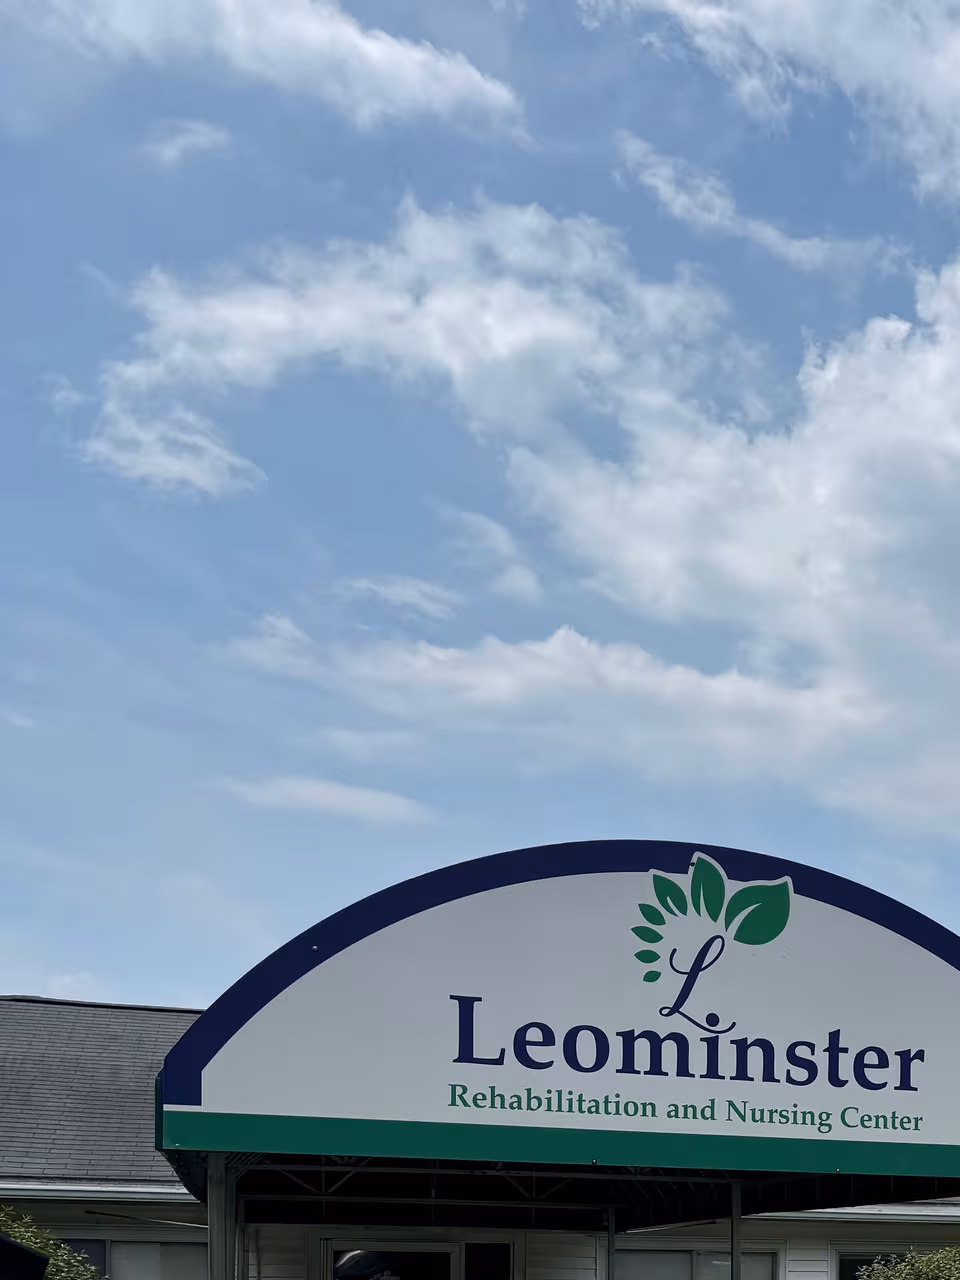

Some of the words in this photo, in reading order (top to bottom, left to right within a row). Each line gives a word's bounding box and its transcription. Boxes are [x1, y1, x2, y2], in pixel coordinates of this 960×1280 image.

[659, 934, 736, 1034] L
[449, 994, 925, 1092] Leominster
[448, 1083, 658, 1119] Rehabilitation
[666, 1098, 717, 1122] and
[725, 1100, 833, 1134] Nursing
[839, 1106, 924, 1131] Center
